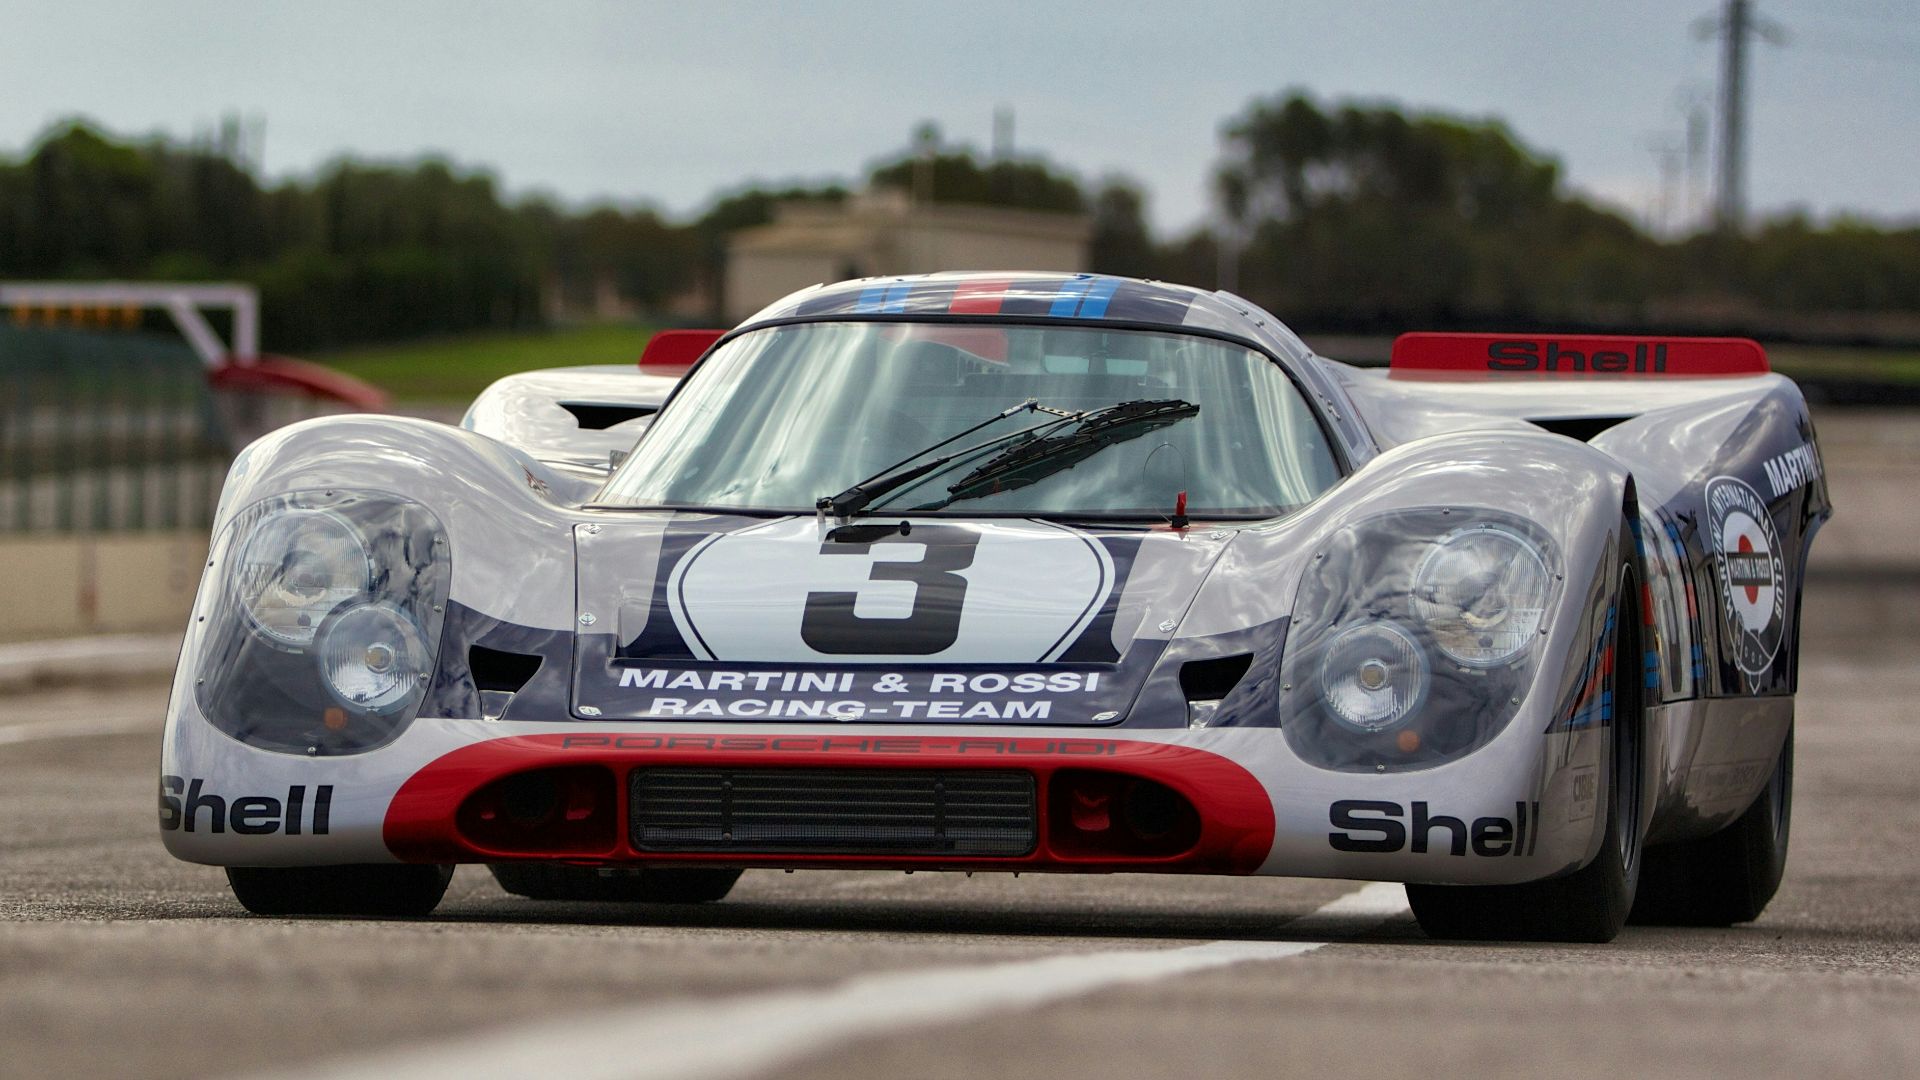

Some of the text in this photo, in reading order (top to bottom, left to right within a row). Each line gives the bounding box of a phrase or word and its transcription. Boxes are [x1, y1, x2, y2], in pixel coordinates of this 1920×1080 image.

[1487, 341, 1668, 373] Shell
[1711, 484, 1784, 620] MARTINI INTERNATIONAL CLUB
[800, 524, 982, 656] 3
[618, 668, 1100, 694] MARTINI & ROSSI
[648, 697, 1052, 719] RACING-TEAM
[562, 736, 1117, 756] PORSCHE-AUDI
[160, 774, 334, 836] Shell
[1328, 799, 1540, 857] Shell
